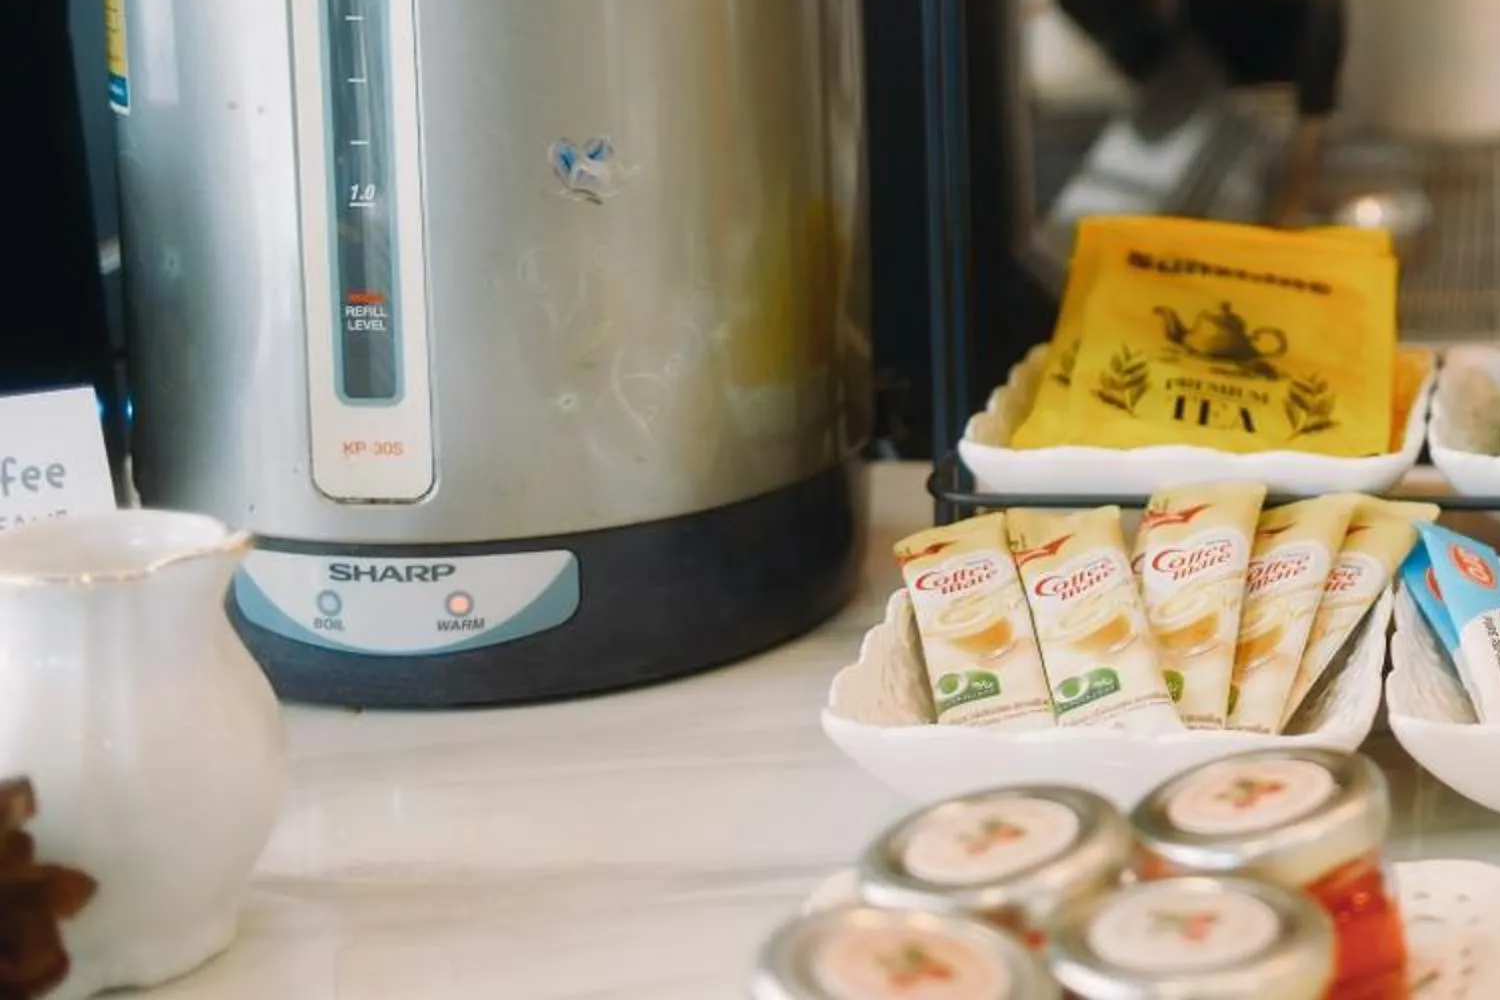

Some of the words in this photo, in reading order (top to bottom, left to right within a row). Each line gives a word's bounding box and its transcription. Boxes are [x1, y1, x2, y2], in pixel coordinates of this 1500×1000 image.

[350, 183, 375, 200] 1.0
[345, 305, 387, 317] REFILL
[347, 319, 386, 331] LEVEL
[1173, 395, 1258, 433] TEA
[329, 563, 456, 582] SHARP
[313, 618, 345, 632] BOIL
[437, 618, 484, 632] WARM
